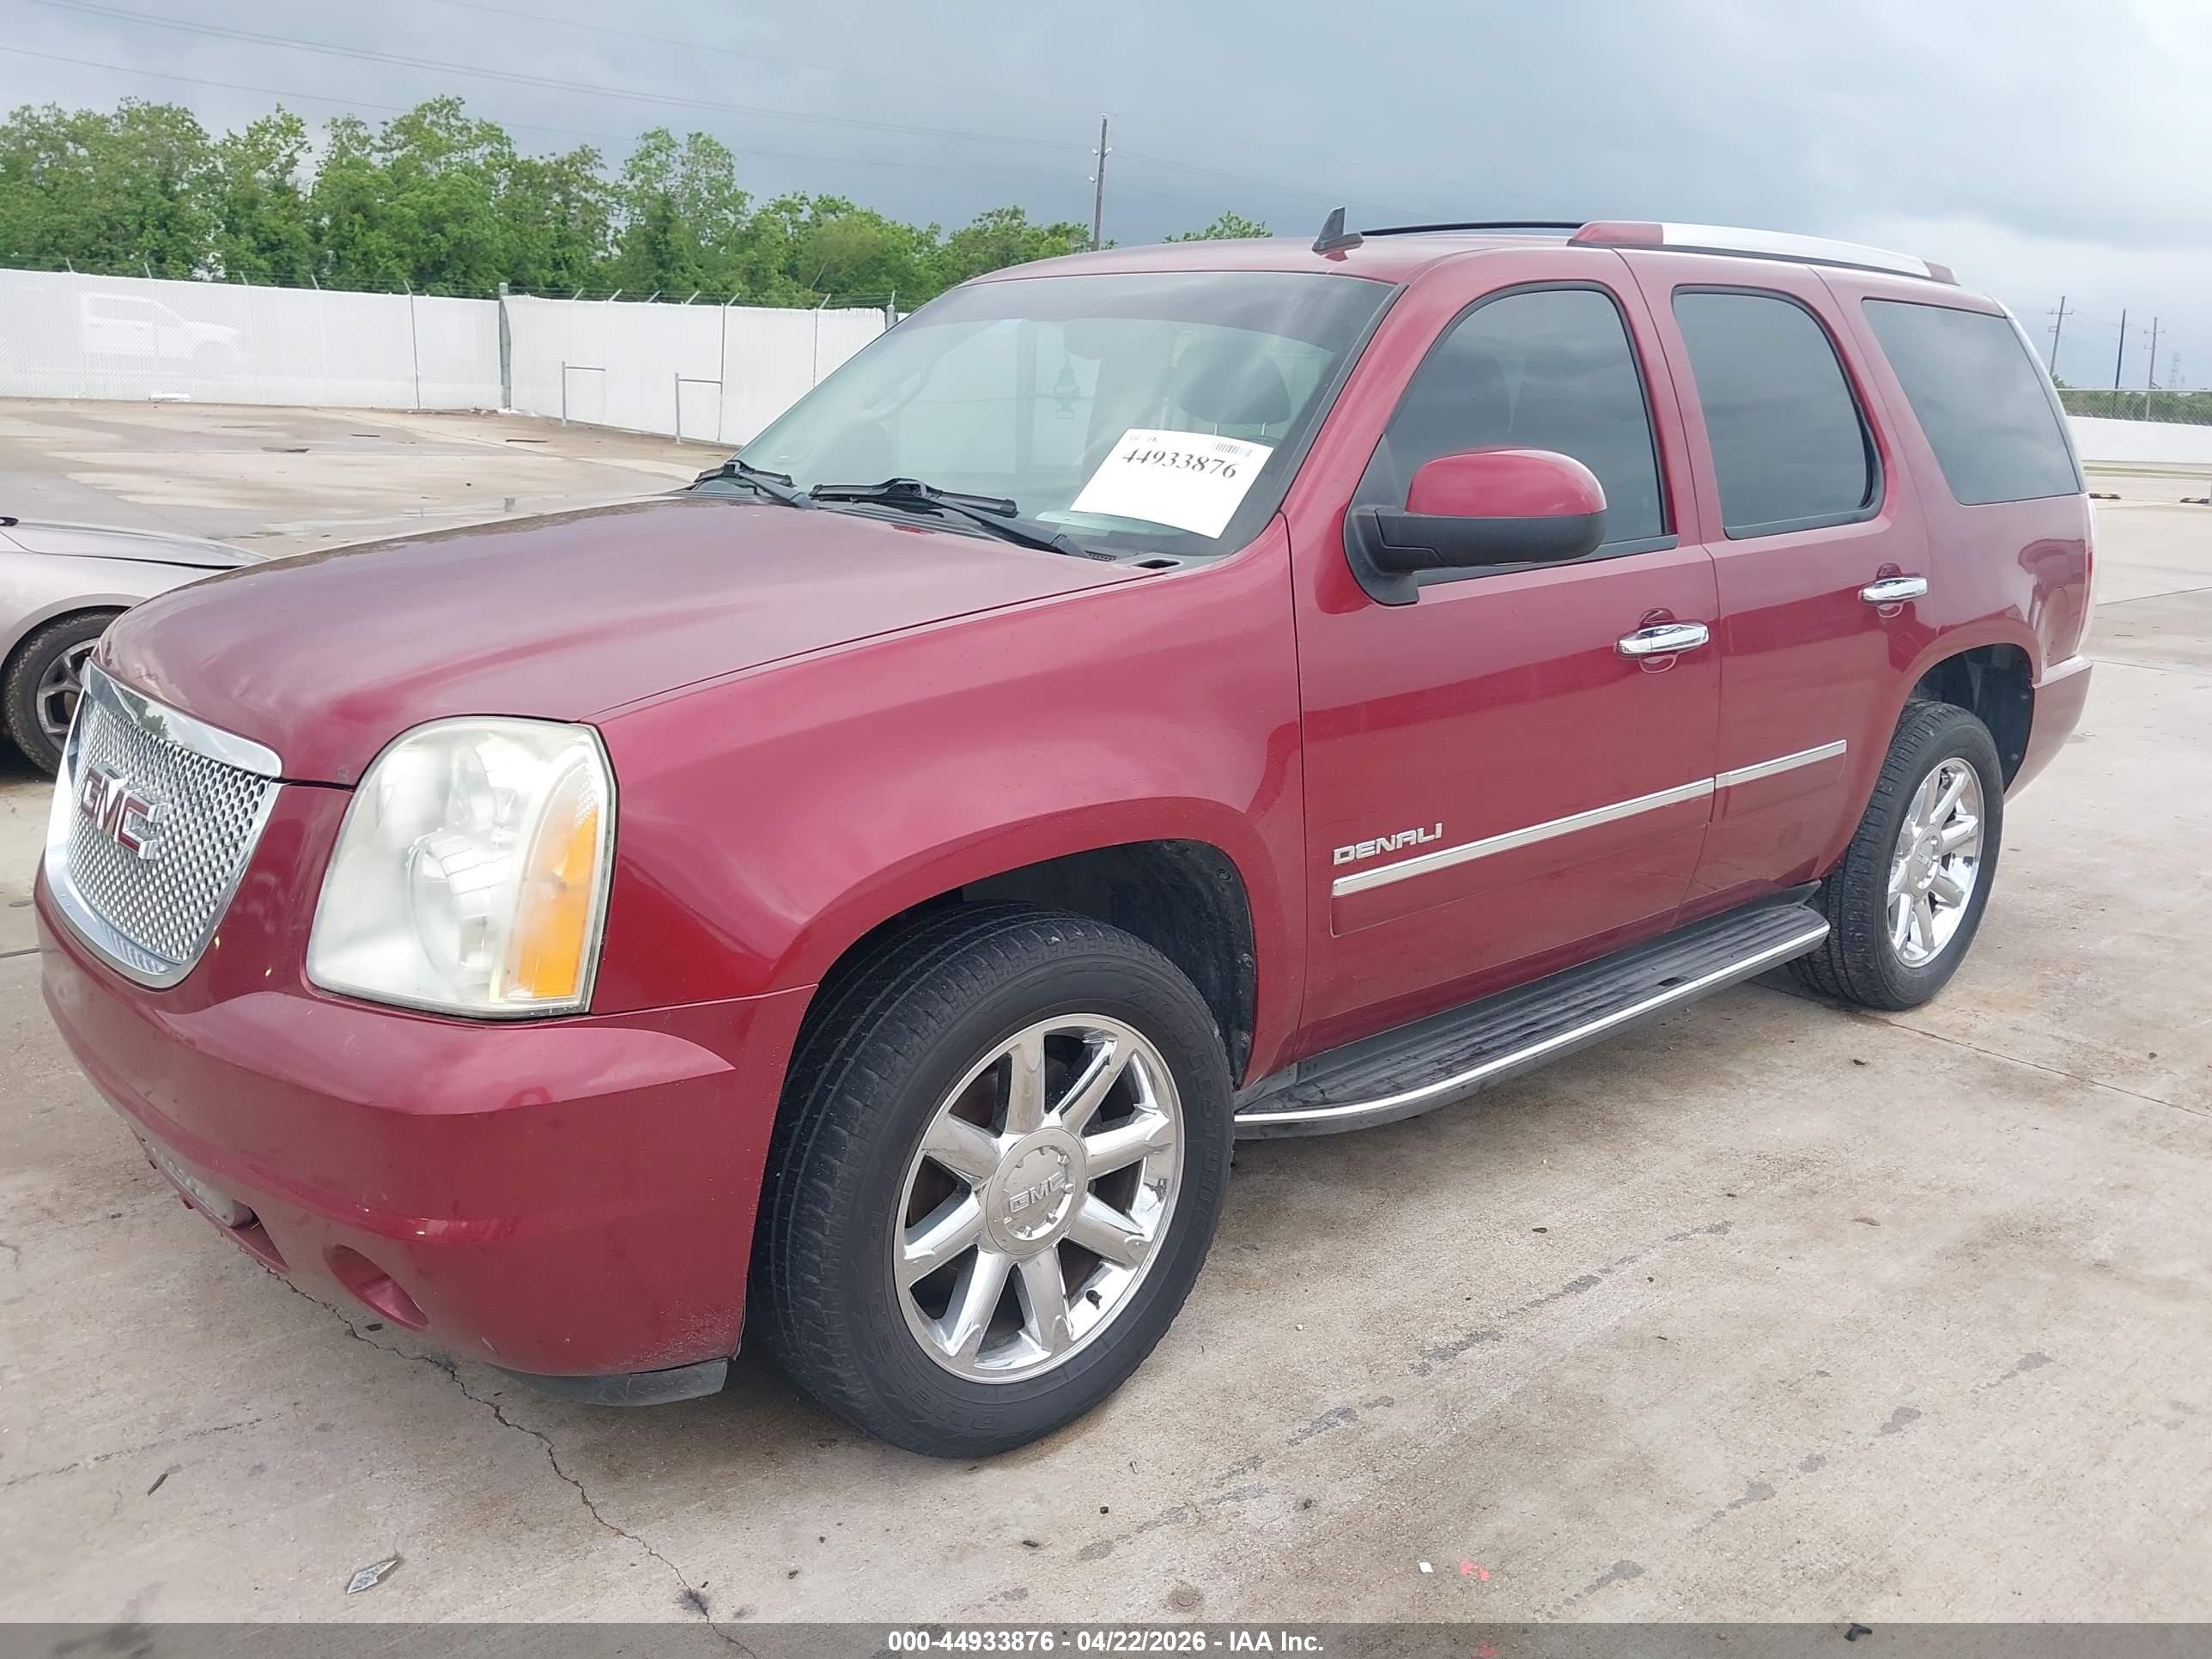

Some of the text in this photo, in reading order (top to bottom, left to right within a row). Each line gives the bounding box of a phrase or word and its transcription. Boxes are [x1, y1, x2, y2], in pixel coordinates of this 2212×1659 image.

[1122, 448, 1239, 478] 44933876
[81, 763, 165, 860] GMC
[1333, 822, 1443, 866] DENALI
[1009, 1171, 1066, 1212] GMC
